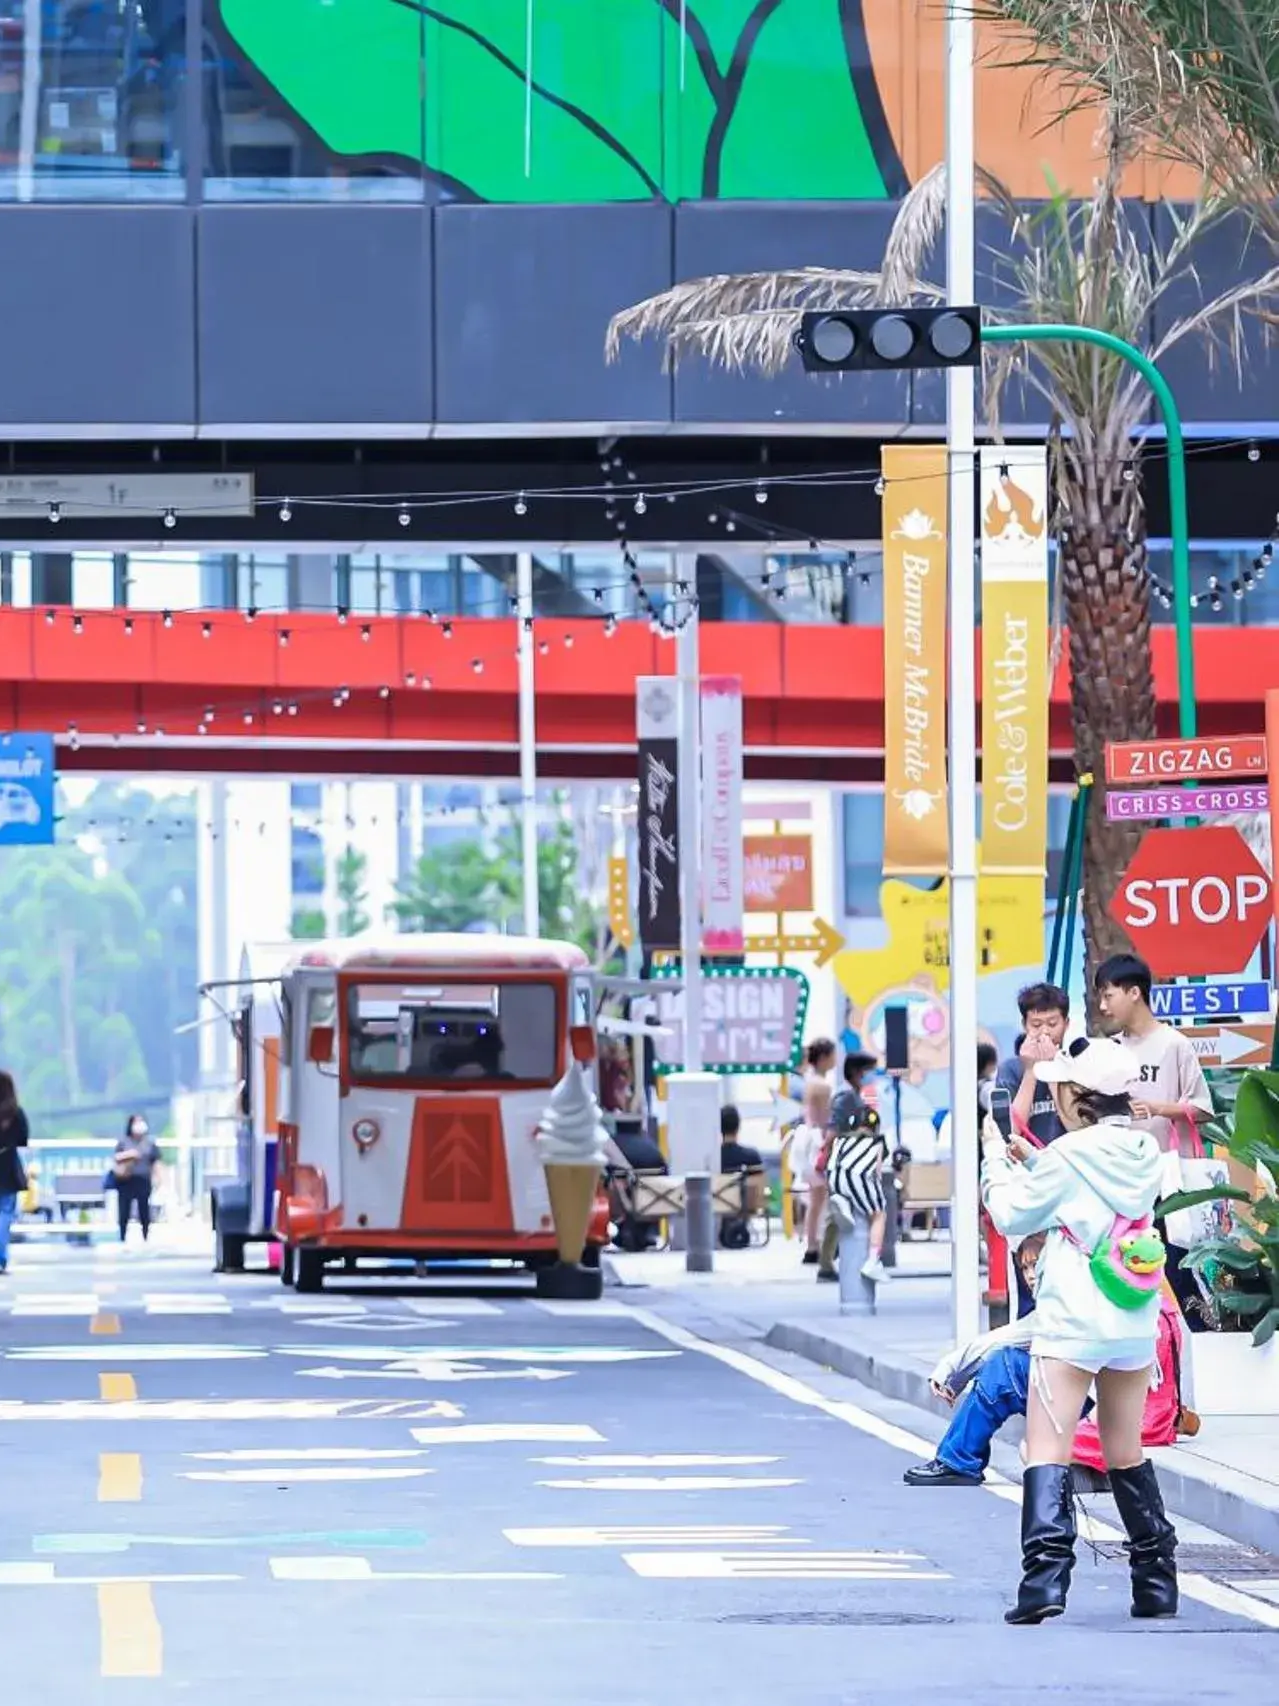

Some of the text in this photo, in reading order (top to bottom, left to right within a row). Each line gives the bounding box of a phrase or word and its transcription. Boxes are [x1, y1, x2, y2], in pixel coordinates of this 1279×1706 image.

[904, 662, 929, 783] McBride
[994, 611, 1028, 832] Cole & Weber
[1130, 747, 1232, 775] ZIGZAG
[1118, 791, 1268, 813] CRISS-CROSS
[1124, 875, 1268, 926] STOP
[1150, 987, 1245, 1013] WEST
